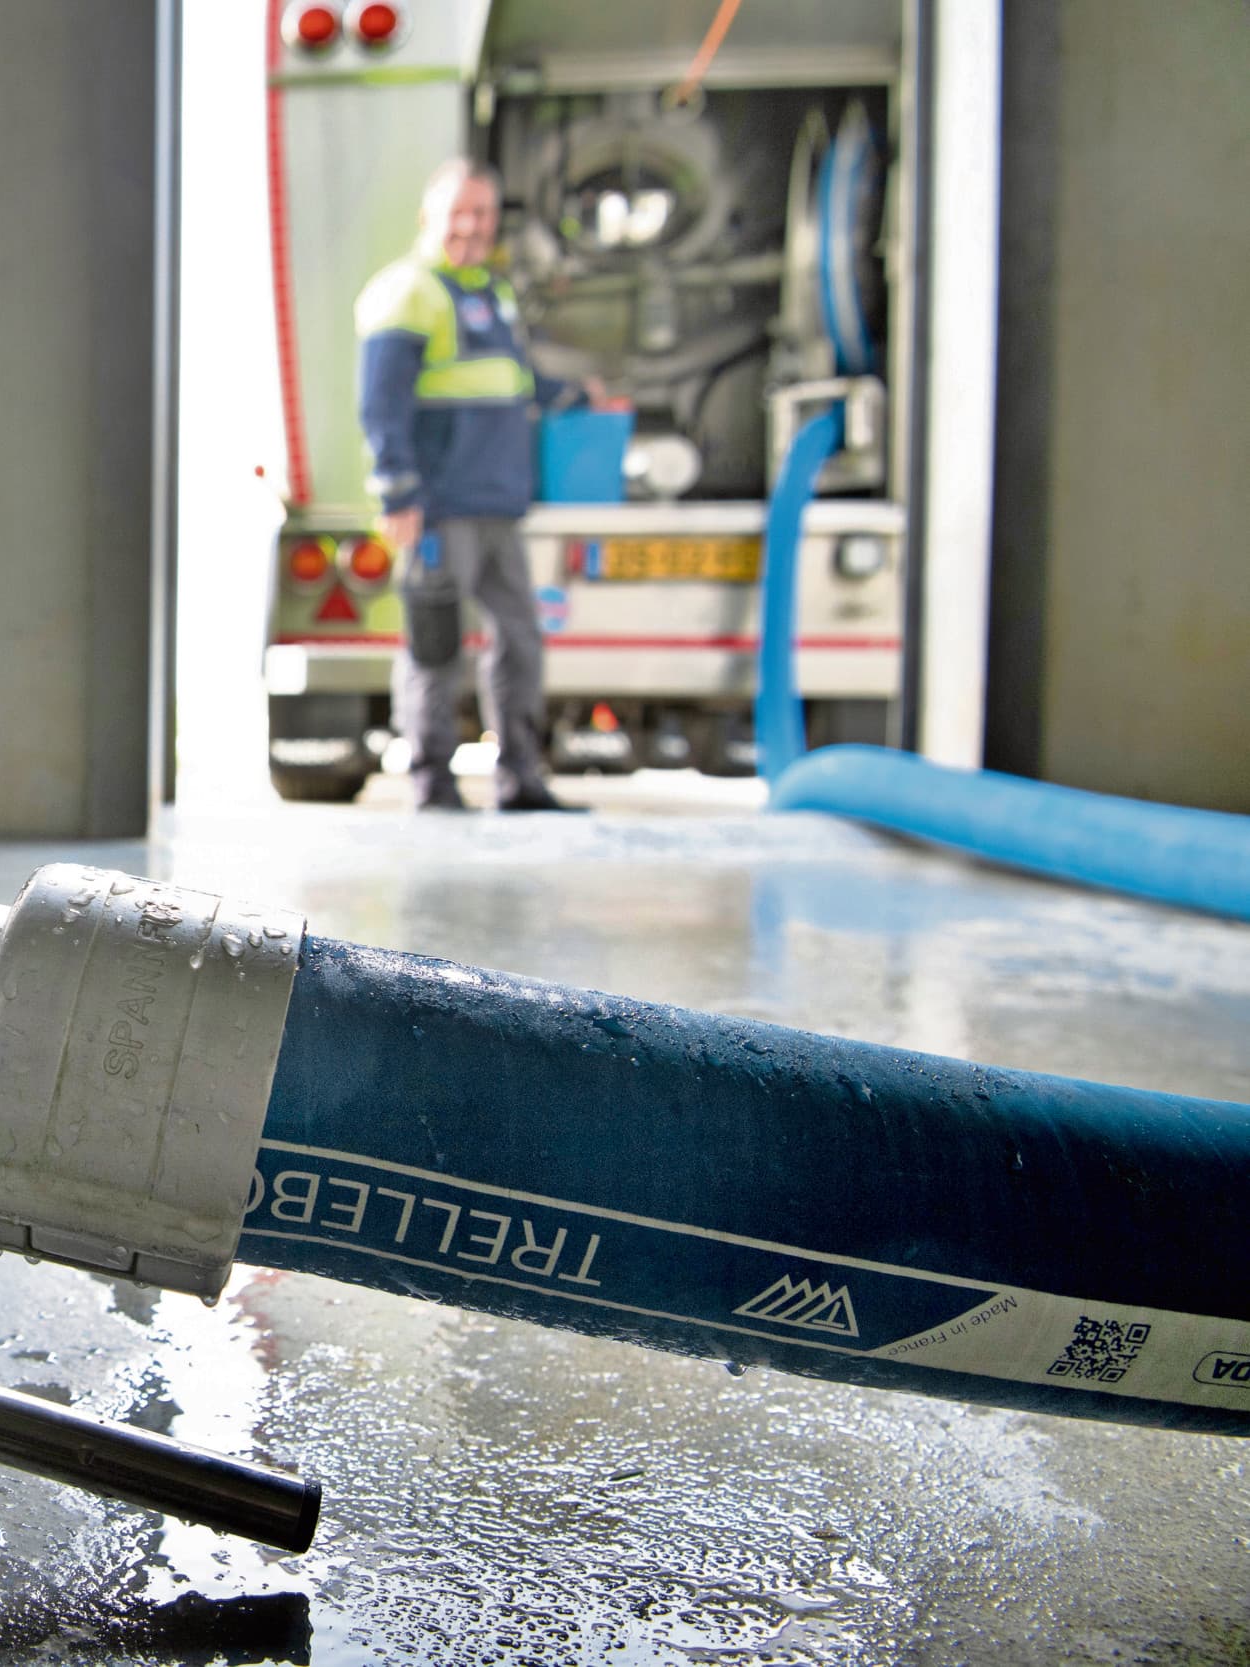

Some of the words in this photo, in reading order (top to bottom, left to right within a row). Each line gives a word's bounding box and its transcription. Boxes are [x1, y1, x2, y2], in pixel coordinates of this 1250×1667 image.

[971, 1295, 1018, 1326] Made
[950, 1322, 968, 1335] in
[888, 1331, 948, 1356] France
